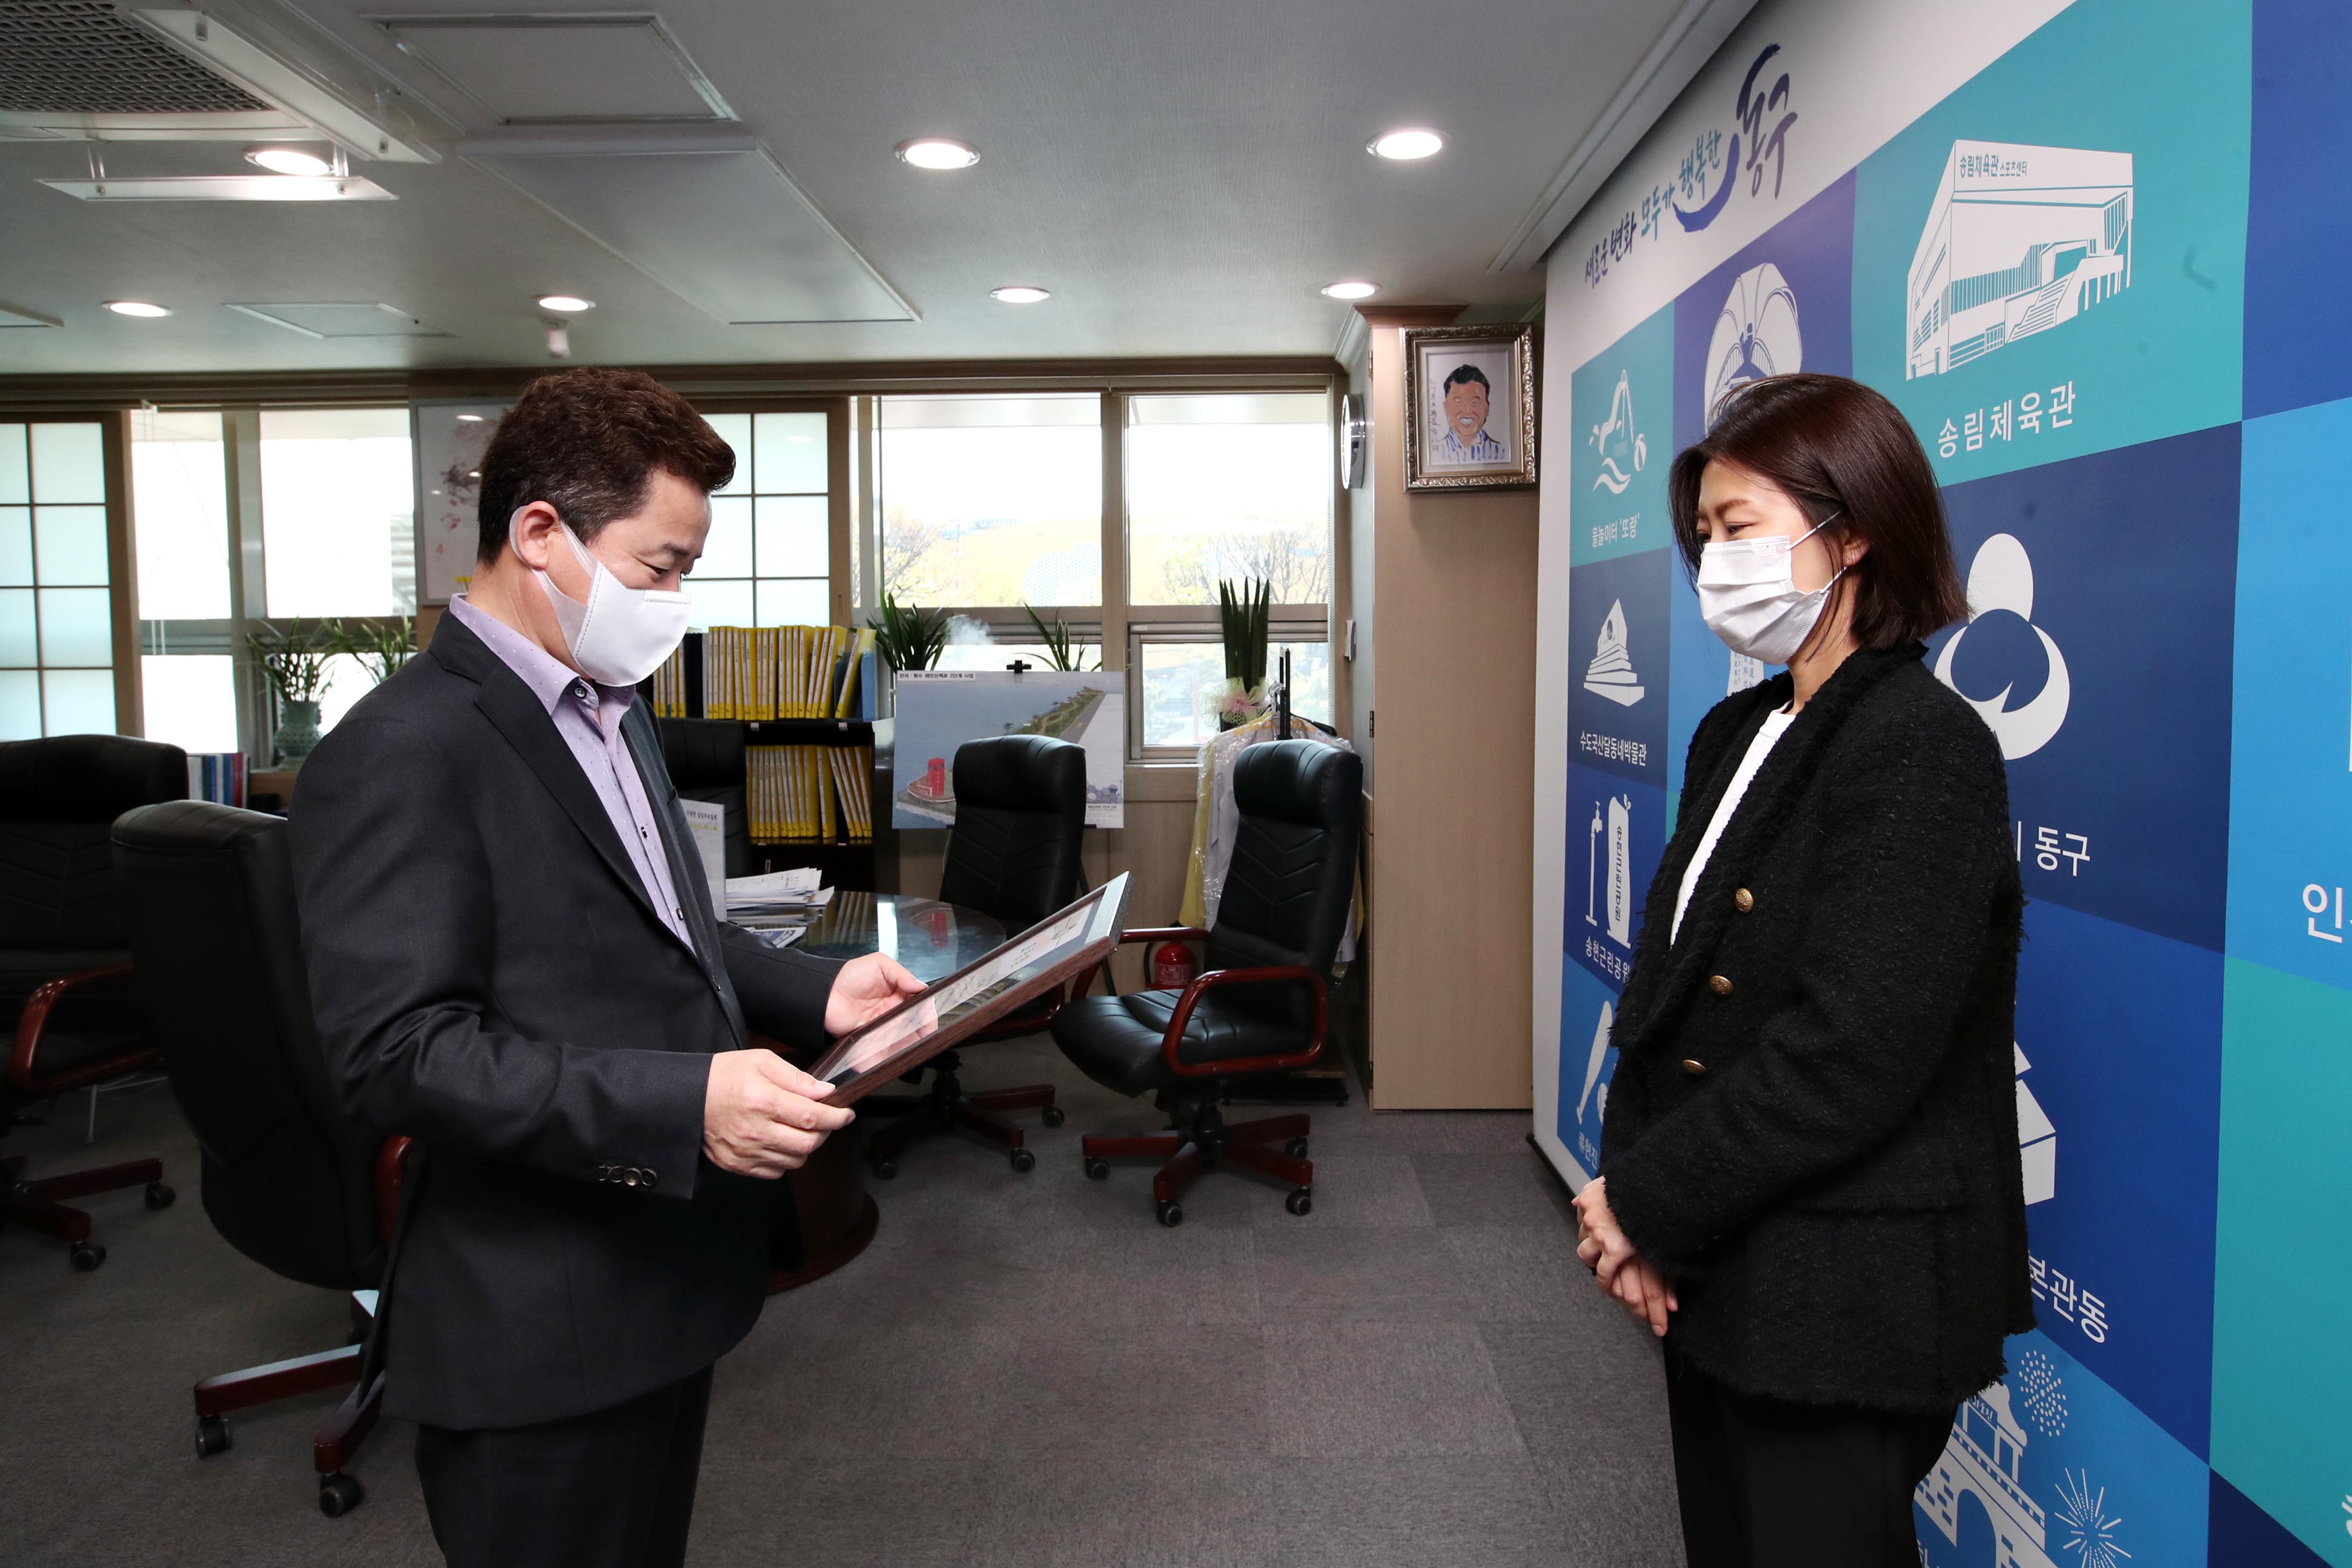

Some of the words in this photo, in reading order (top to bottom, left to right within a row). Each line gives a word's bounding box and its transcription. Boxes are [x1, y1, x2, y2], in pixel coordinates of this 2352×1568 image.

[1960, 153, 1999, 178] 송림체육관
[1999, 161, 2028, 177] 스포츠센터
[1585, 237, 1608, 289] 새로운
[1611, 211, 1637, 262] 변화
[1641, 182, 1676, 241] 모두가
[1678, 129, 1722, 201] 행복한
[1938, 380, 2076, 459] 송림체육관
[1592, 520, 1618, 548] 물놀이터
[1580, 730, 1647, 766] 수도국산달동네박물관
[2034, 826, 2090, 877] 동구
[1585, 936, 1630, 984] 송현근린공원
[1578, 1132, 1598, 1170] 류현진
